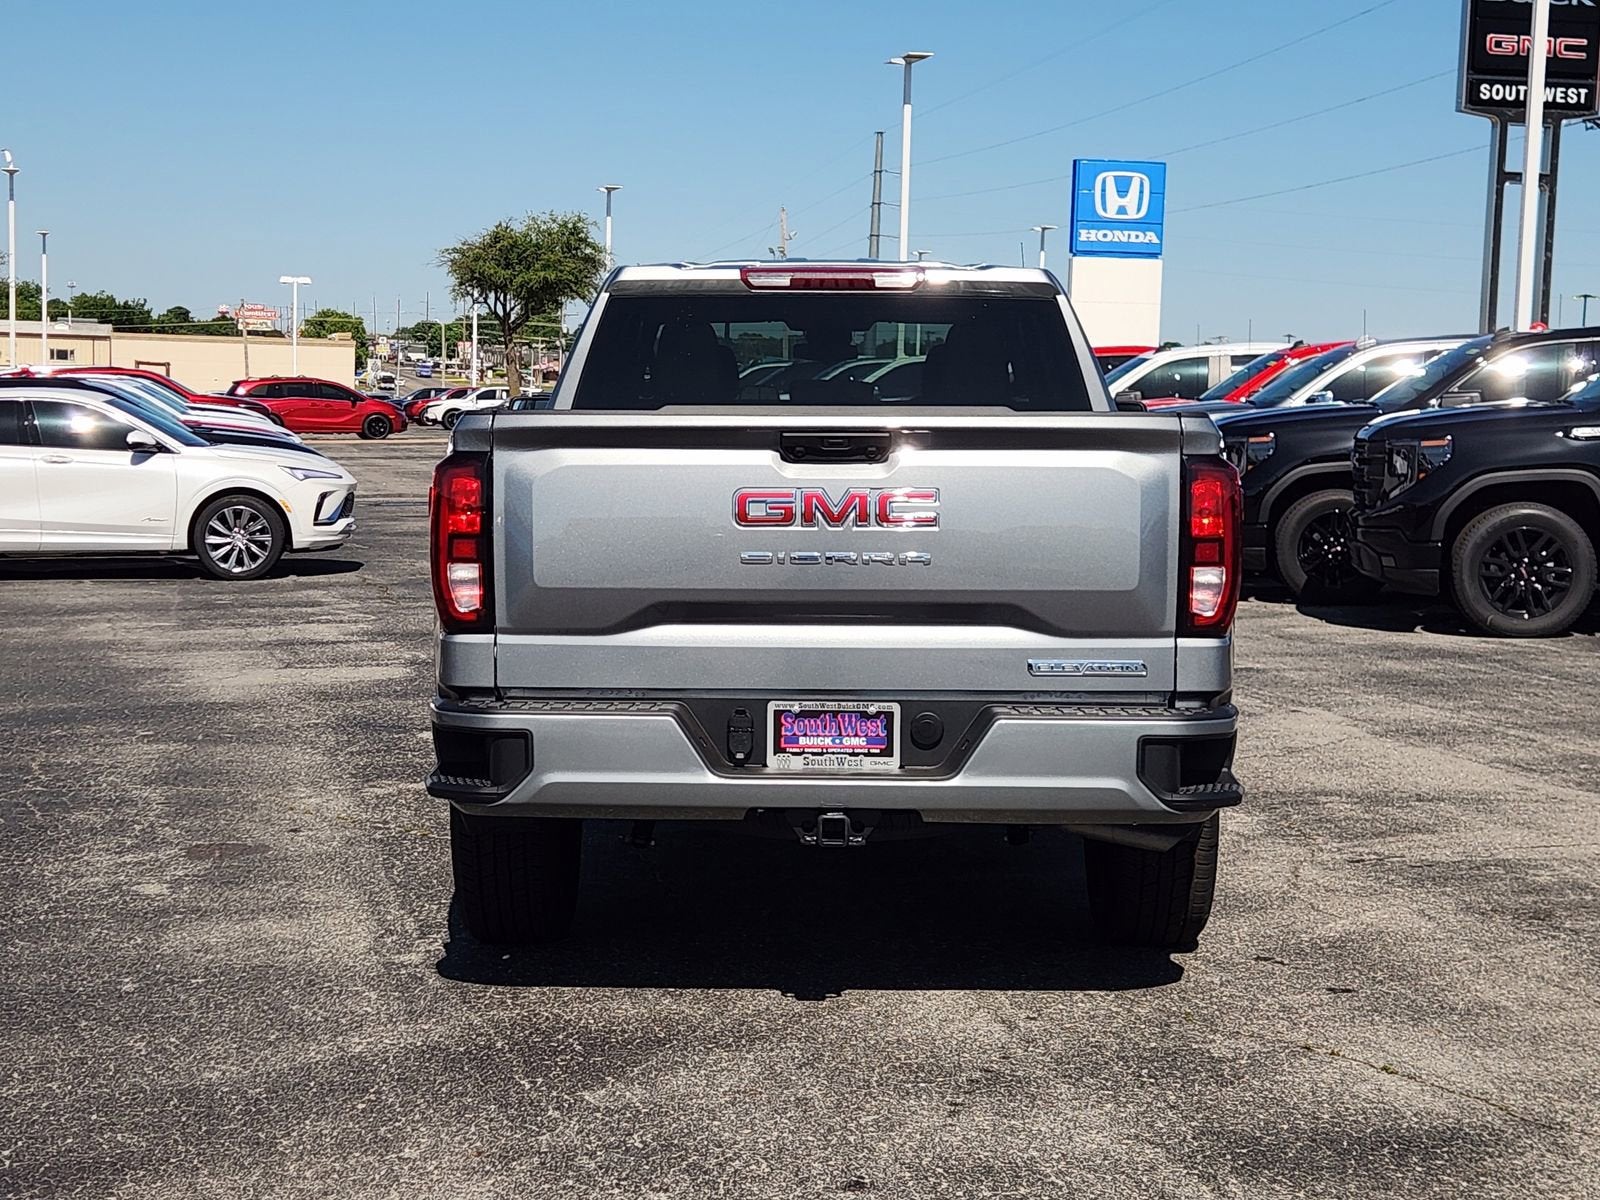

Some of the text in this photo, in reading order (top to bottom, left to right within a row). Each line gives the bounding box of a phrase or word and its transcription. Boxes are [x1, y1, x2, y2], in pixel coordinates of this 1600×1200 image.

[1486, 33, 1588, 59] GMC
[1479, 83, 1589, 104] SOUTWEST
[1078, 229, 1160, 243] HONDA
[732, 487, 940, 531] GMC
[740, 551, 931, 566] SIERRA
[1034, 660, 1142, 674] ELEVATION
[774, 702, 893, 710] wwwSouthWestBuickGMC.com
[781, 712, 887, 736] SouthWest
[798, 737, 867, 746] BUICK GMC
[803, 756, 863, 767] SouthWest
